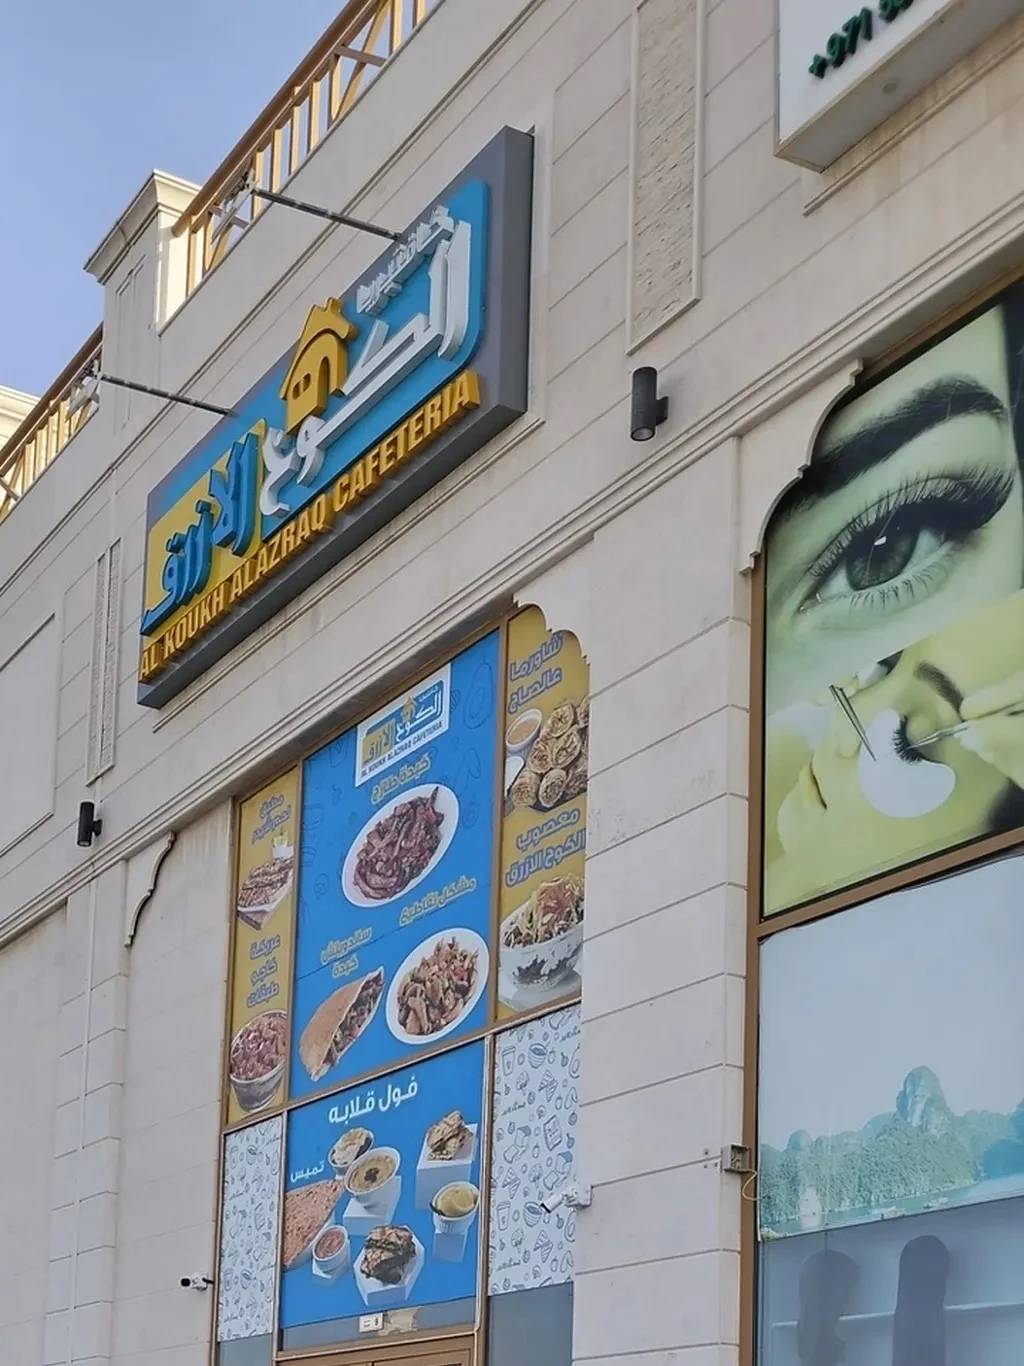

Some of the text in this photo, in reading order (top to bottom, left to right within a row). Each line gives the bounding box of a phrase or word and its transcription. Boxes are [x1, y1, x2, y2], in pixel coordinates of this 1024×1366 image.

[808, 6, 873, 79] +971
[138, 640, 164, 683] AL
[163, 580, 230, 660] KOUKH
[332, 369, 478, 513] CAFETERIA
[510, 632, 563, 682] شاورما
[508, 667, 562, 714] عالصاج
[516, 808, 580, 852] معصوب
[378, 1075, 418, 1112] فول
[290, 1160, 324, 1182] تميس
